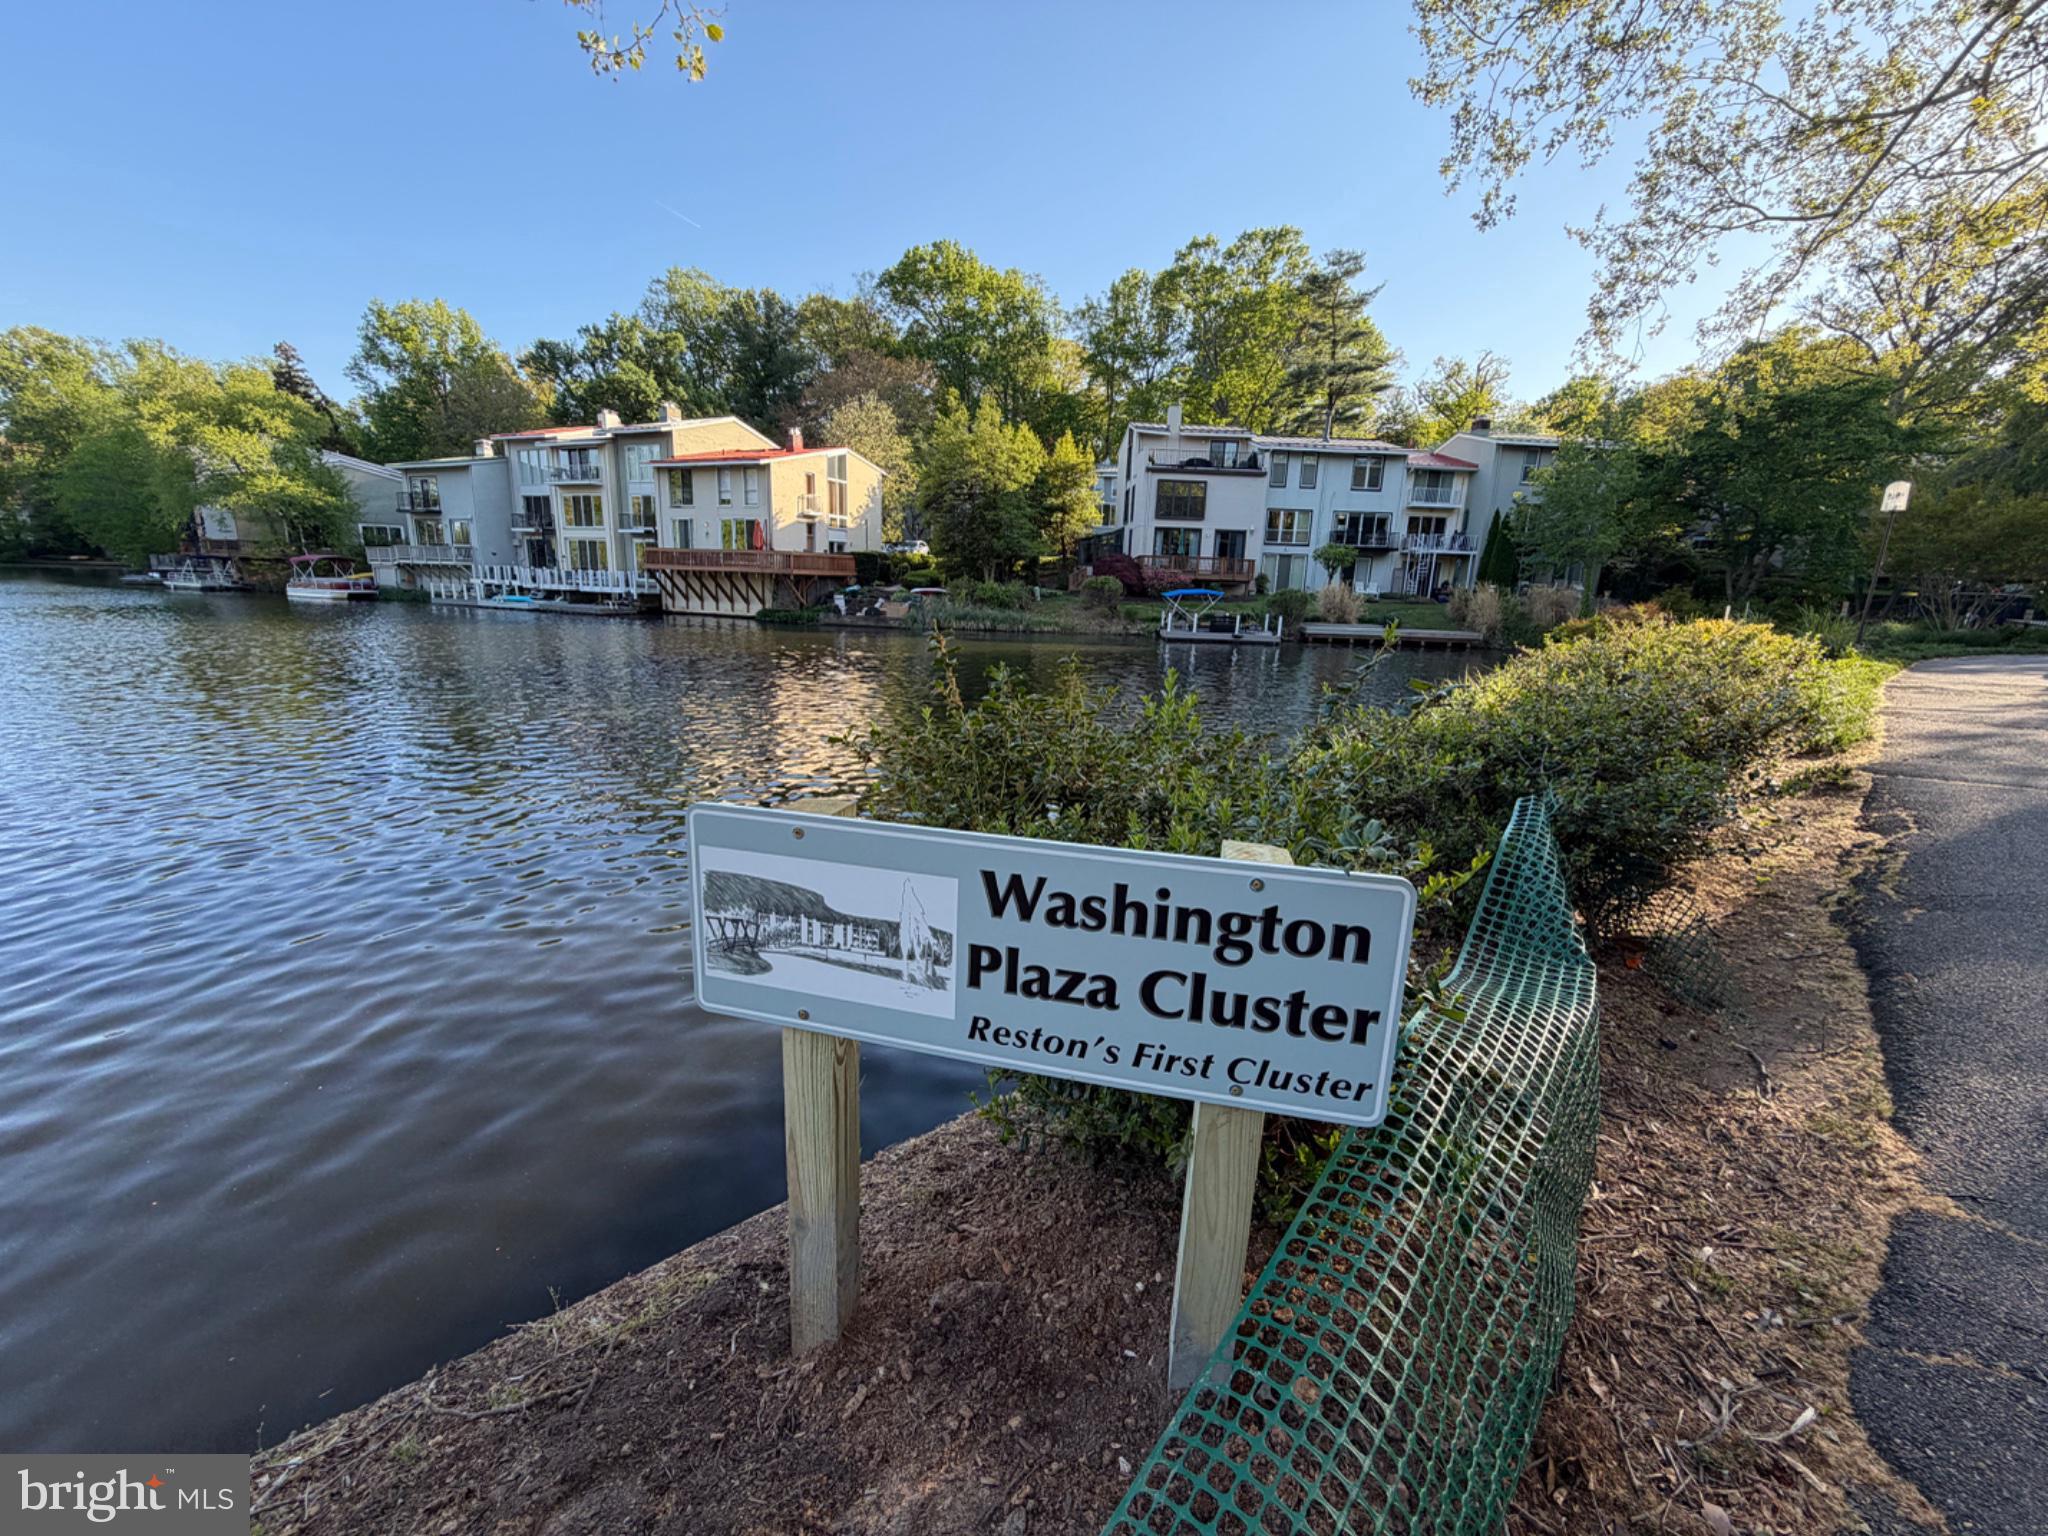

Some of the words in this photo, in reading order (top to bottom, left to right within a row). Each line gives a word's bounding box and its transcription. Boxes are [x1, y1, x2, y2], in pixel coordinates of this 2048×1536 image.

[981, 870, 1371, 965] Washington
[967, 943, 1119, 1010] Plaza
[1139, 969, 1380, 1045] Cluster
[968, 1015, 1120, 1065] Reston's
[1135, 1042, 1214, 1080] First
[1227, 1057, 1373, 1102] Cluster
